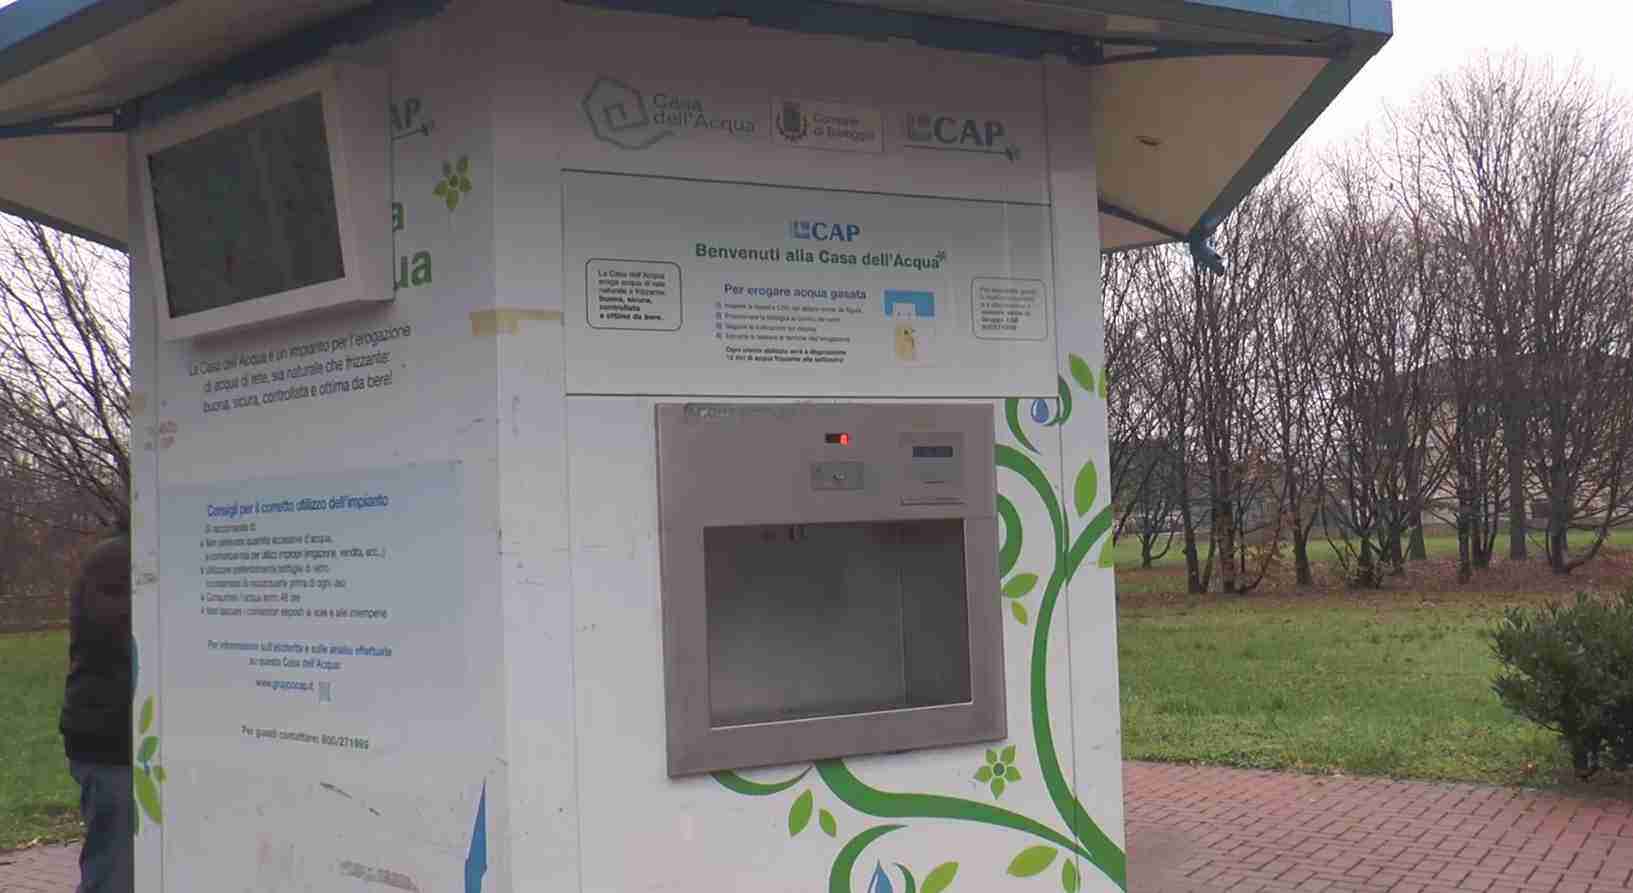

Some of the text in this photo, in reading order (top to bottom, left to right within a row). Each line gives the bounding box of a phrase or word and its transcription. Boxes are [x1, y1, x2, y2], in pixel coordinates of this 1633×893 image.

[391, 98, 421, 132] AP
[934, 116, 1005, 146] CAP
[811, 221, 860, 241] CAP
[395, 250, 432, 288] ua
[695, 243, 940, 270] Benvenuti alla Casa dell'Acqua
[724, 282, 867, 301] Per erogare acqua gasata
[332, 336, 348, 354] per
[287, 362, 323, 379] naturale
[325, 358, 343, 372] che
[262, 384, 309, 405] controllata
[319, 378, 350, 396] ottima
[352, 376, 365, 390] da
